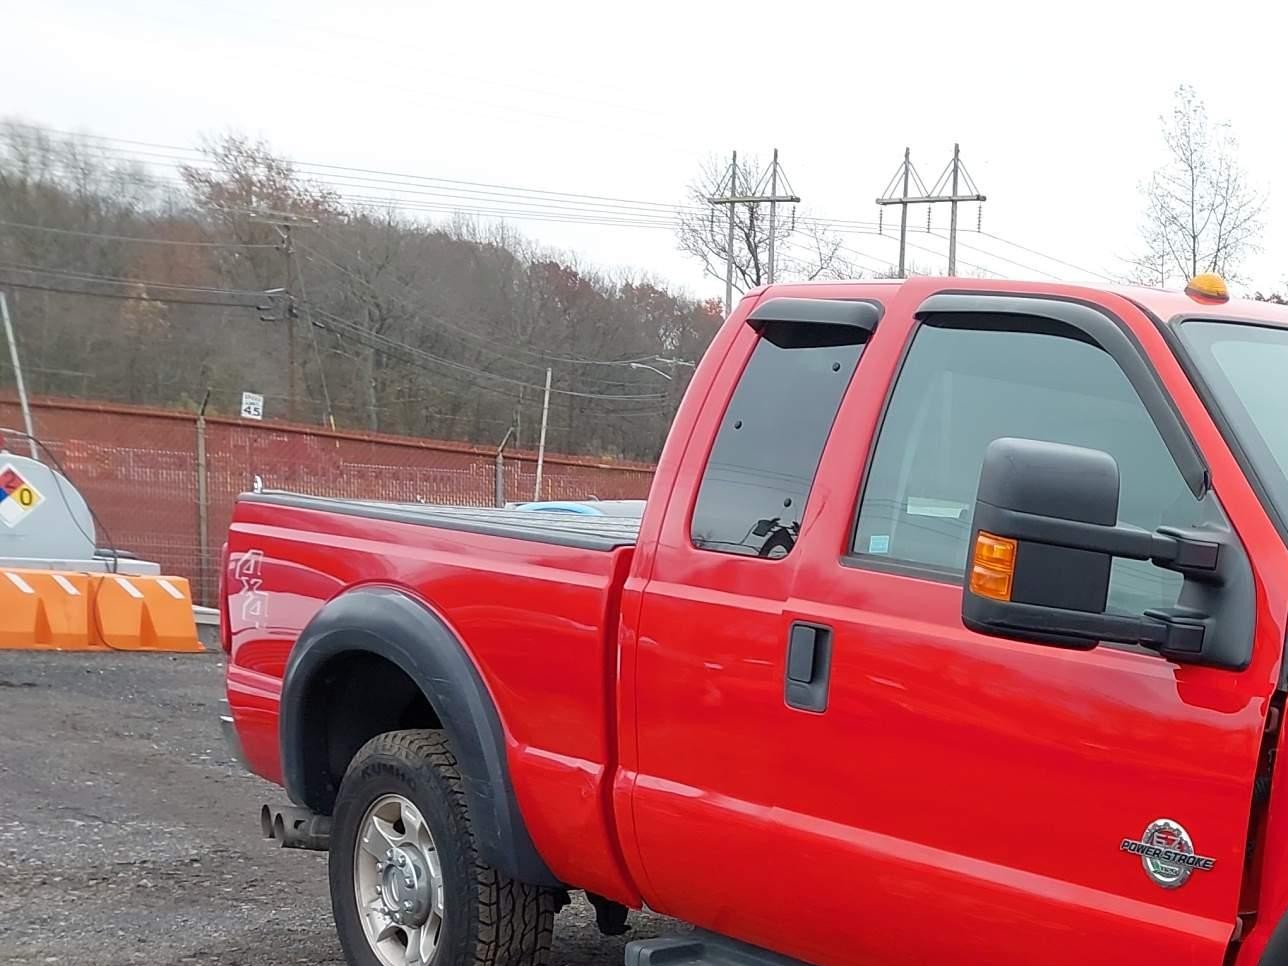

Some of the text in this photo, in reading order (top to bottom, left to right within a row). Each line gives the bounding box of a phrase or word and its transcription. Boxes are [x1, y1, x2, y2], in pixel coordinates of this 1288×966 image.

[243, 406, 261, 417] 45
[20, 488, 32, 506] 0
[1123, 841, 1214, 869] POWER STROKE
